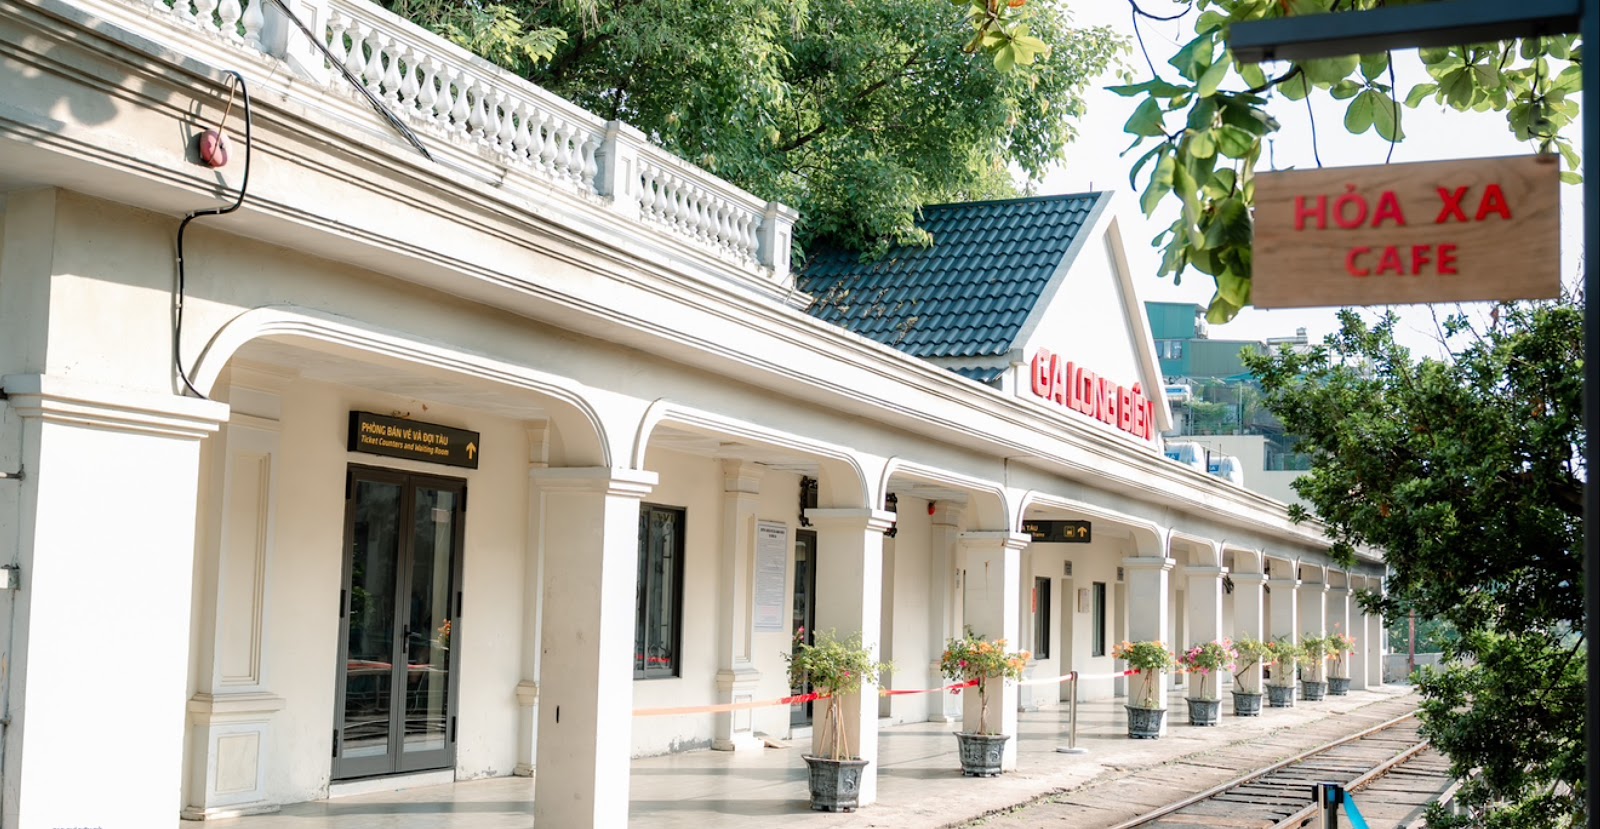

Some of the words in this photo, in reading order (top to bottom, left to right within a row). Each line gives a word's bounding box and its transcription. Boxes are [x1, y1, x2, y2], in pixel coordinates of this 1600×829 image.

[1294, 184, 1406, 231] HỎA
[1435, 184, 1512, 224] XA
[1344, 244, 1460, 278] CAFE
[1031, 346, 1064, 406] GA
[1066, 361, 1117, 425] LONG
[361, 421, 386, 435] PHÒNG
[387, 425, 402, 437] BÁN
[413, 430, 422, 441] VÀ
[435, 433, 448, 445] TÀU
[361, 434, 378, 445] Ticket
[379, 437, 403, 448] Counters
[415, 444, 433, 454] Waiting
[434, 446, 448, 455] Room
